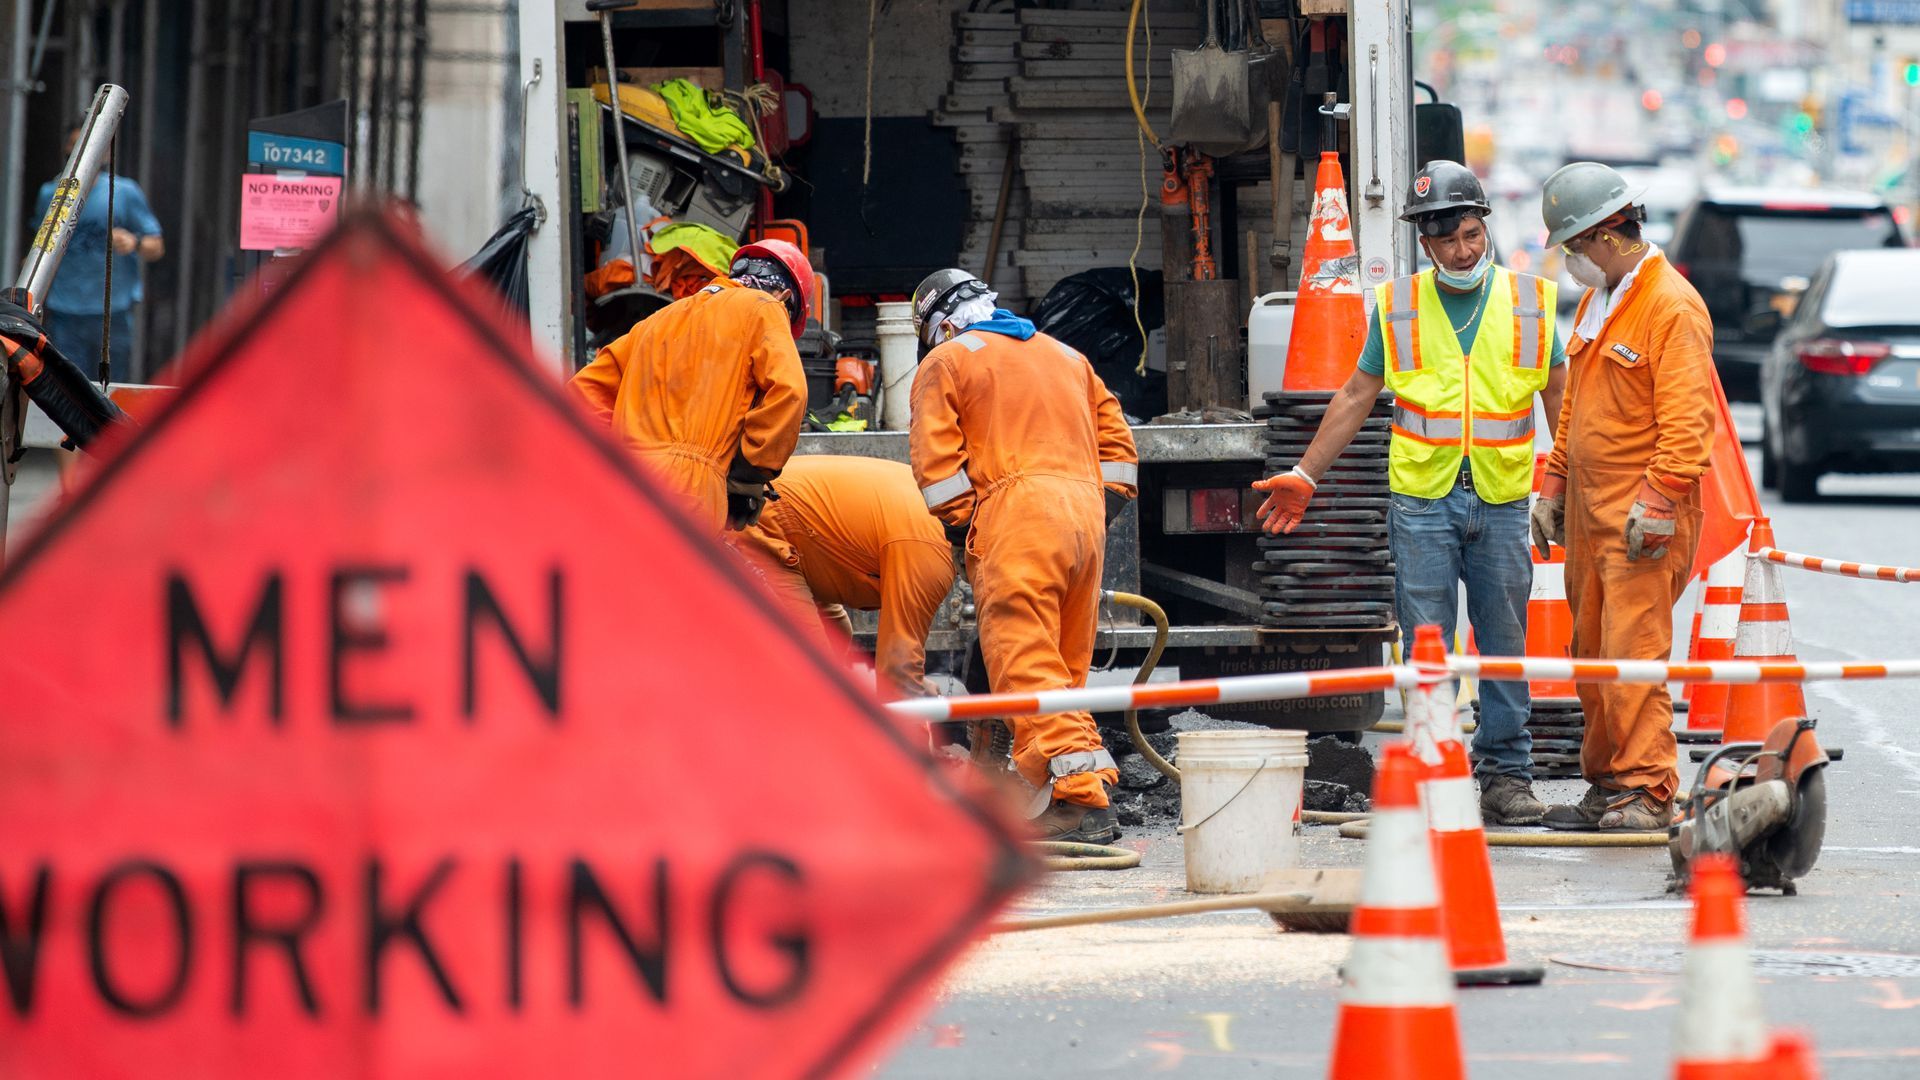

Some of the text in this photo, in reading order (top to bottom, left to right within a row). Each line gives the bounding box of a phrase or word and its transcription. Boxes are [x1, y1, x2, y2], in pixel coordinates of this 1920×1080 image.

[263, 147, 326, 164] 107342
[249, 183, 333, 196] NO PARKING
[163, 566, 566, 728] MEN
[1220, 657, 1331, 673] truck sales corp
